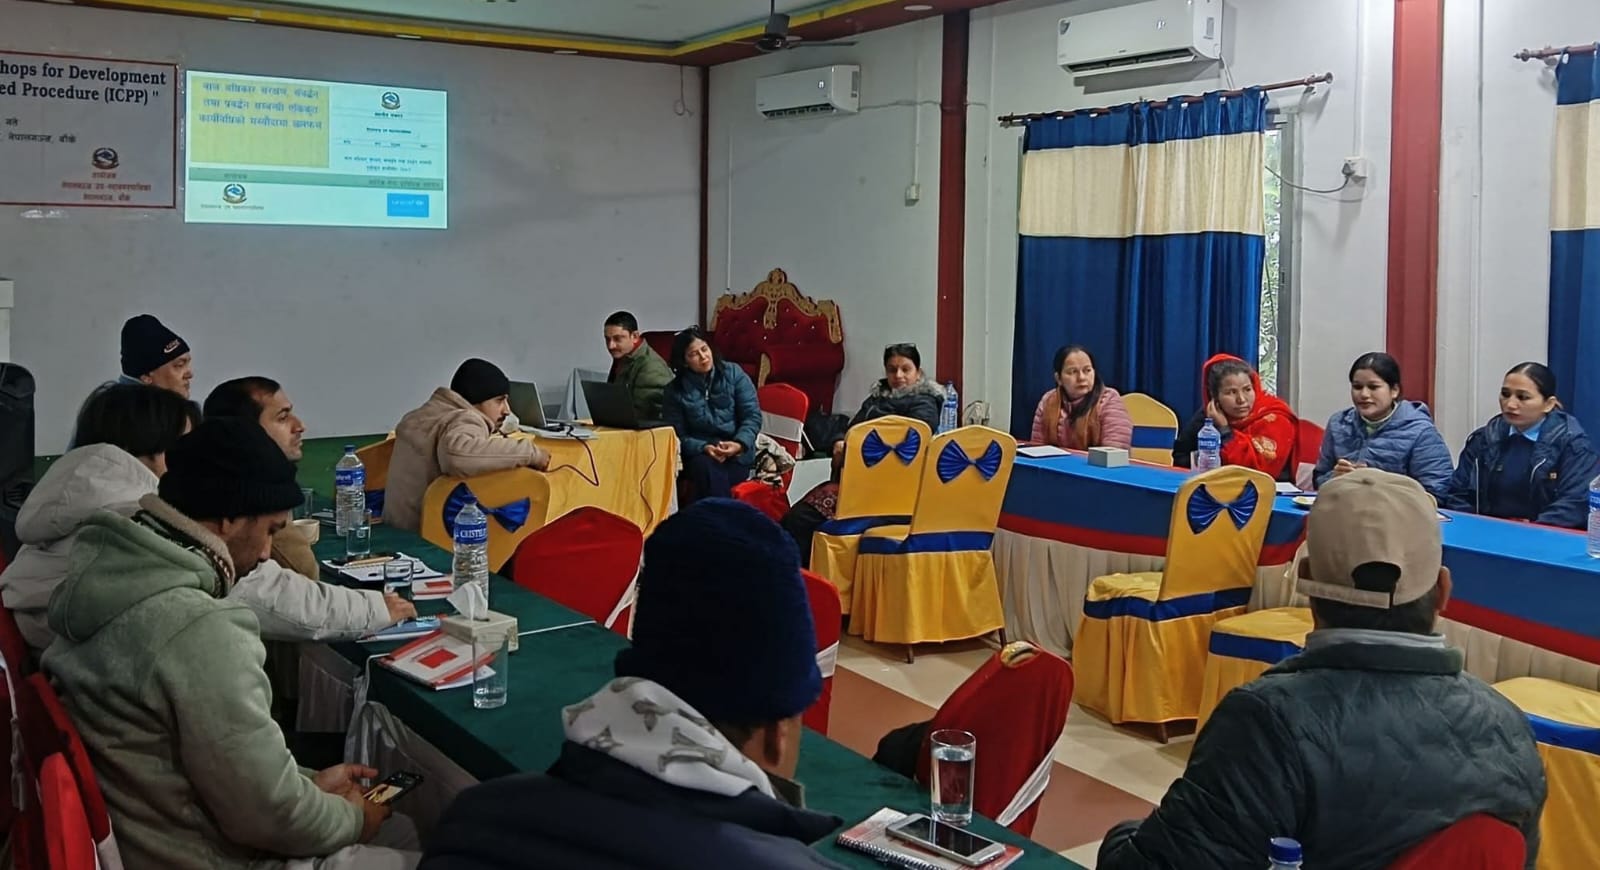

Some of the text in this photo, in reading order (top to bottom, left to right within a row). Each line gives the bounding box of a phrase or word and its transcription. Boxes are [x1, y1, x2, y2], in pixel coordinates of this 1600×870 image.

[42, 62, 64, 78] for
[69, 65, 167, 86] Development
[22, 82, 99, 101] Procedure
[104, 87, 148, 106] (ICPP)
